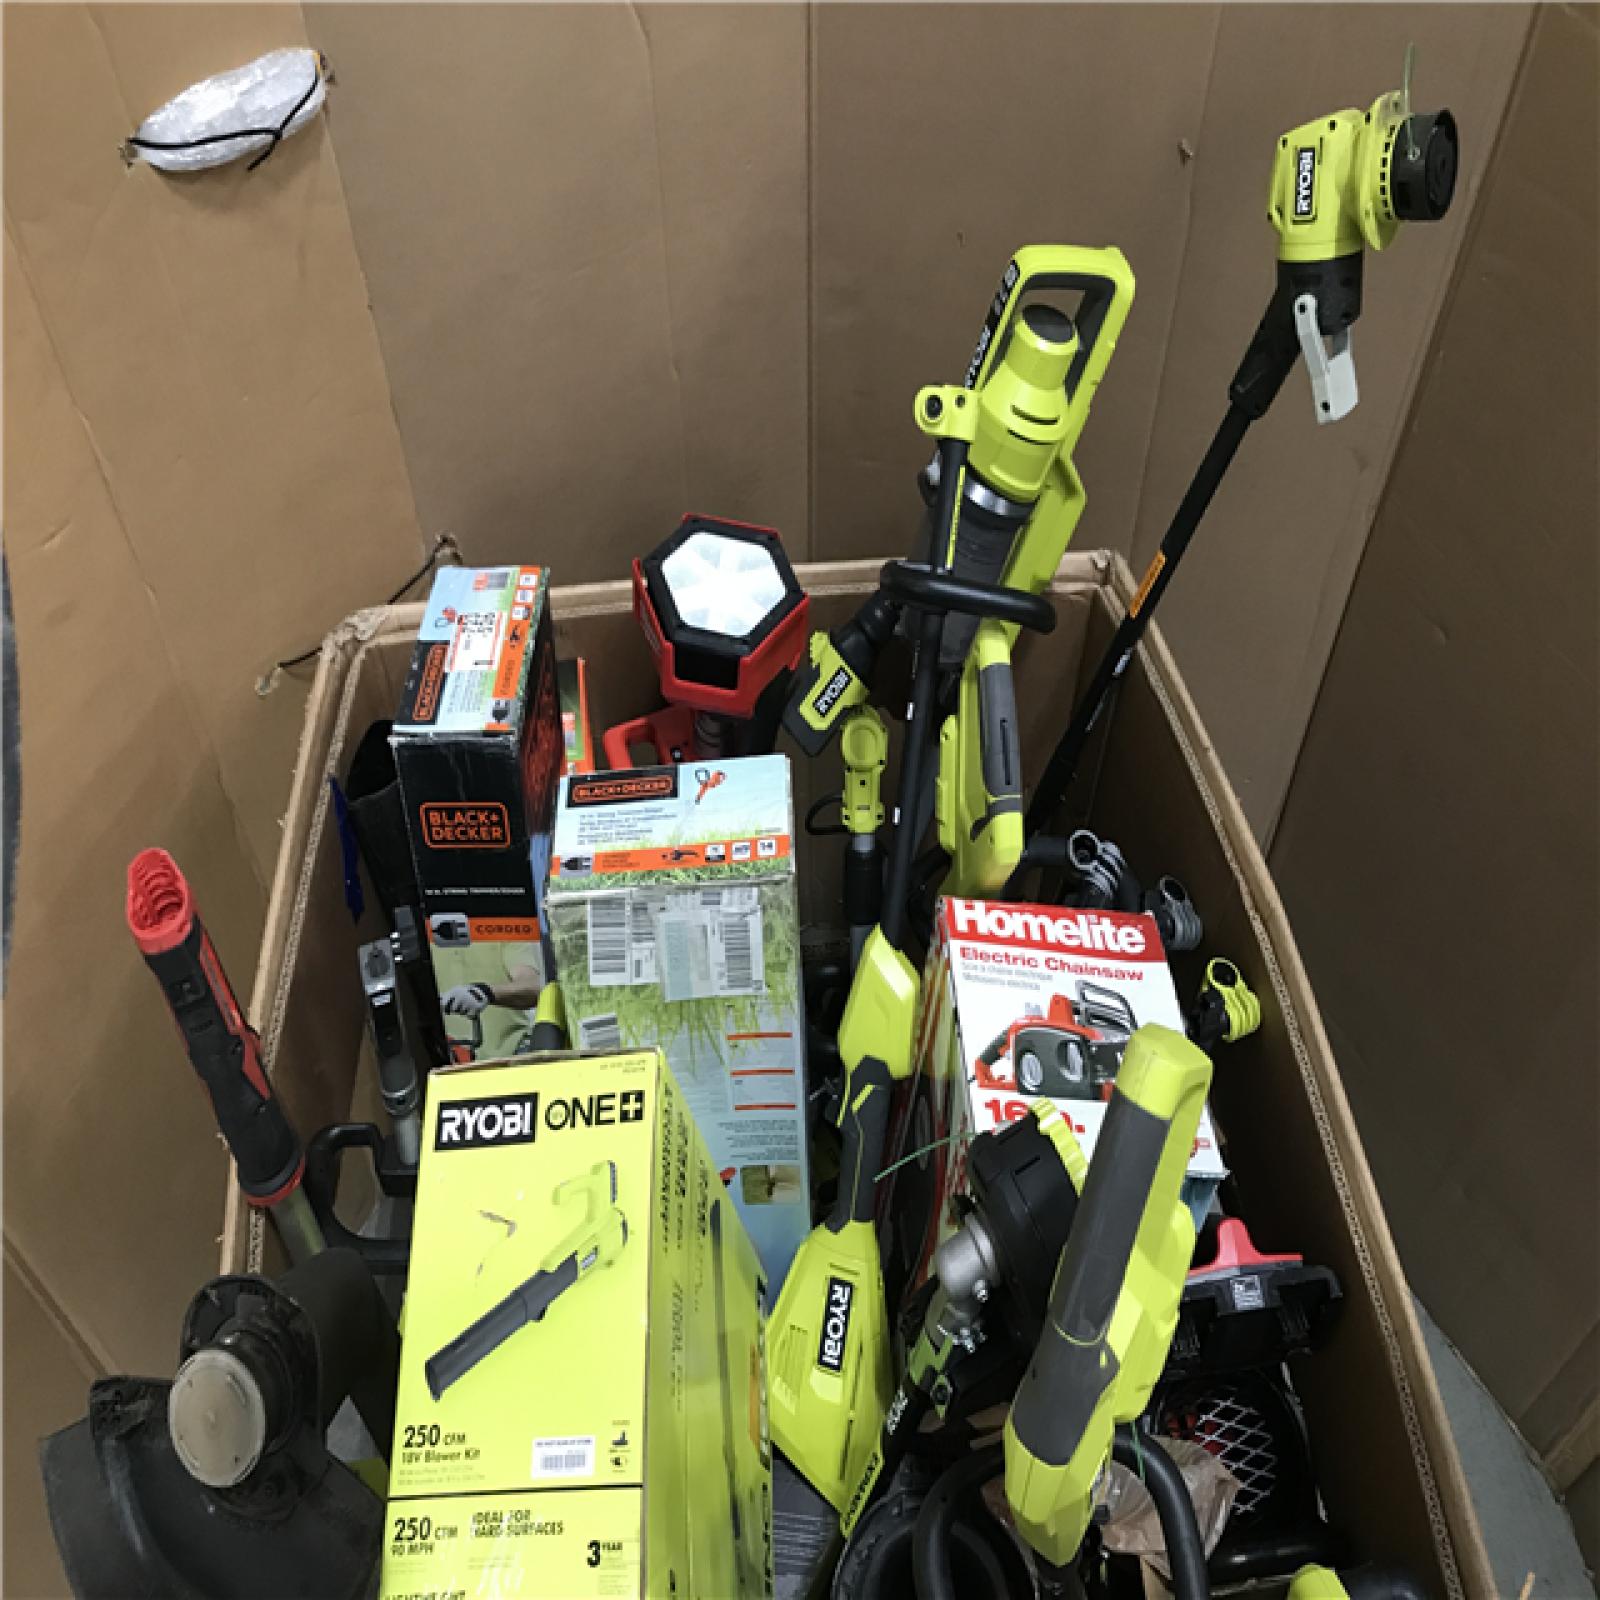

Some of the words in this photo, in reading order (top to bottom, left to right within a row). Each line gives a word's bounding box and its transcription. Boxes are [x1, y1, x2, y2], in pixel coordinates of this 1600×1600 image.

[1296, 151, 1314, 214] RYOBI
[815, 669, 849, 714] RYOBI
[431, 826, 503, 841] DECKER
[952, 898, 1146, 954] Homelite
[959, 946, 1039, 969] Electric
[1044, 955, 1144, 981] Chainsaw
[438, 1101, 532, 1143] RYOBI
[822, 1284, 850, 1366] RYOBI
[402, 1424, 441, 1448] 250
[424, 1450, 461, 1464] Blower
[464, 1447, 481, 1461] Kit
[393, 1515, 433, 1542] 250
[471, 1511, 504, 1525] IDEAL
[506, 1520, 565, 1537] SURFACES
[407, 1541, 434, 1556] MPH
[586, 1540, 601, 1568] 3
[602, 1541, 624, 1551] YEAR
